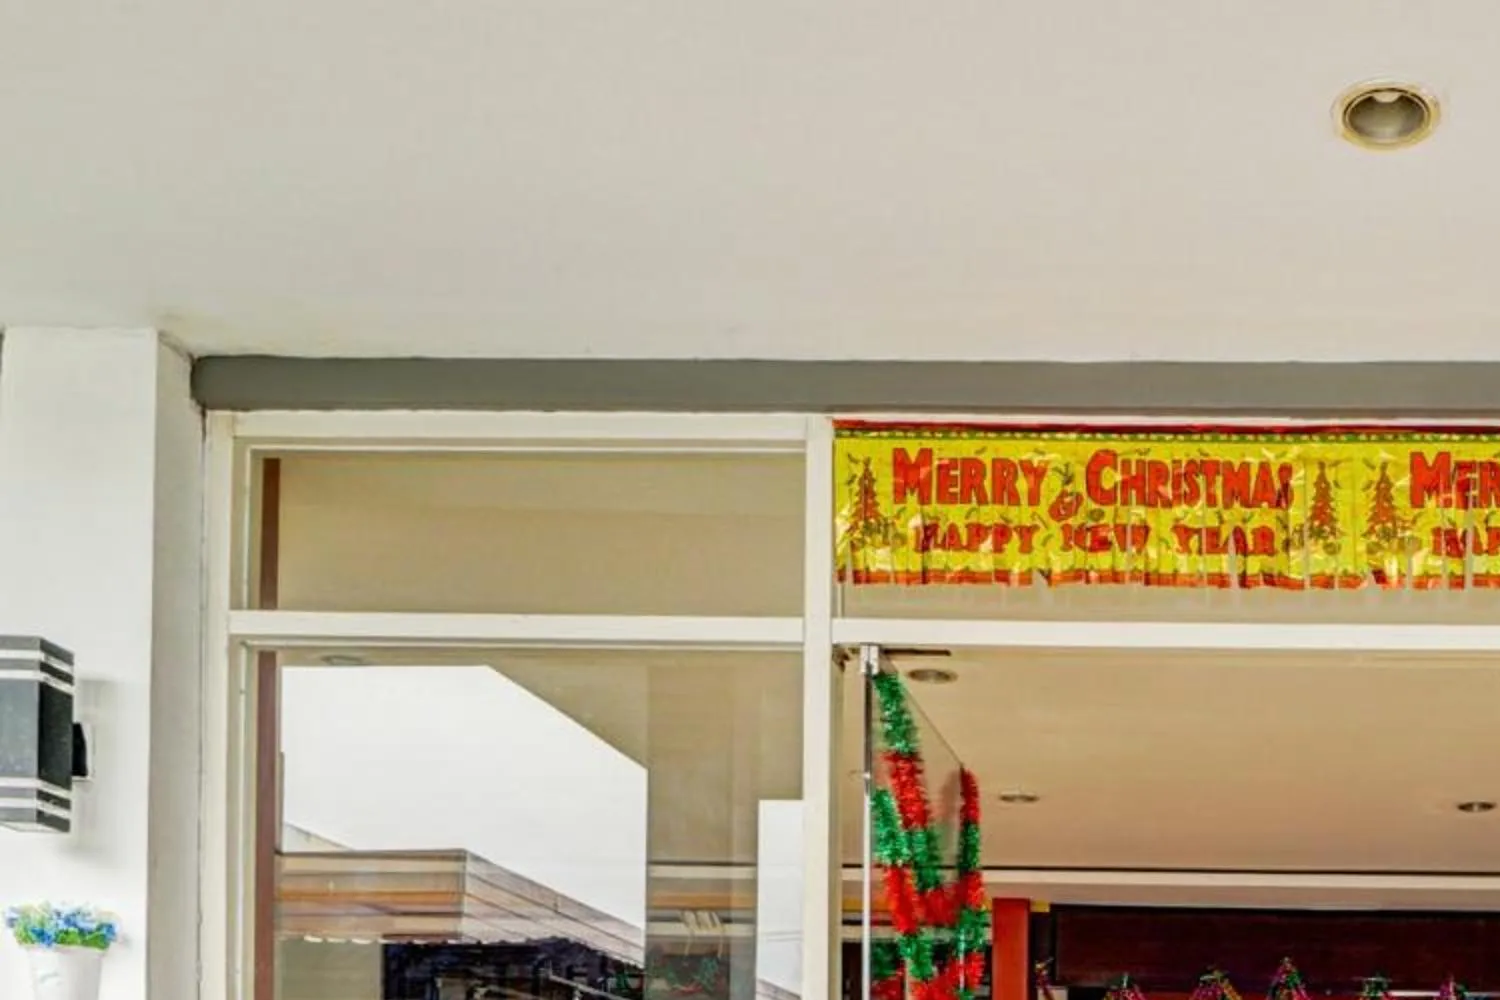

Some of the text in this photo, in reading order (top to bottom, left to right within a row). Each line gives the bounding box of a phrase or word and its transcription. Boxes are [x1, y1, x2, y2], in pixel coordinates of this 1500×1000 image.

[893, 448, 1048, 506] MERRY
[1086, 449, 1293, 508] CHRISTMAS
[914, 521, 1039, 554] HAPPY
[1171, 524, 1276, 556] YEAR
